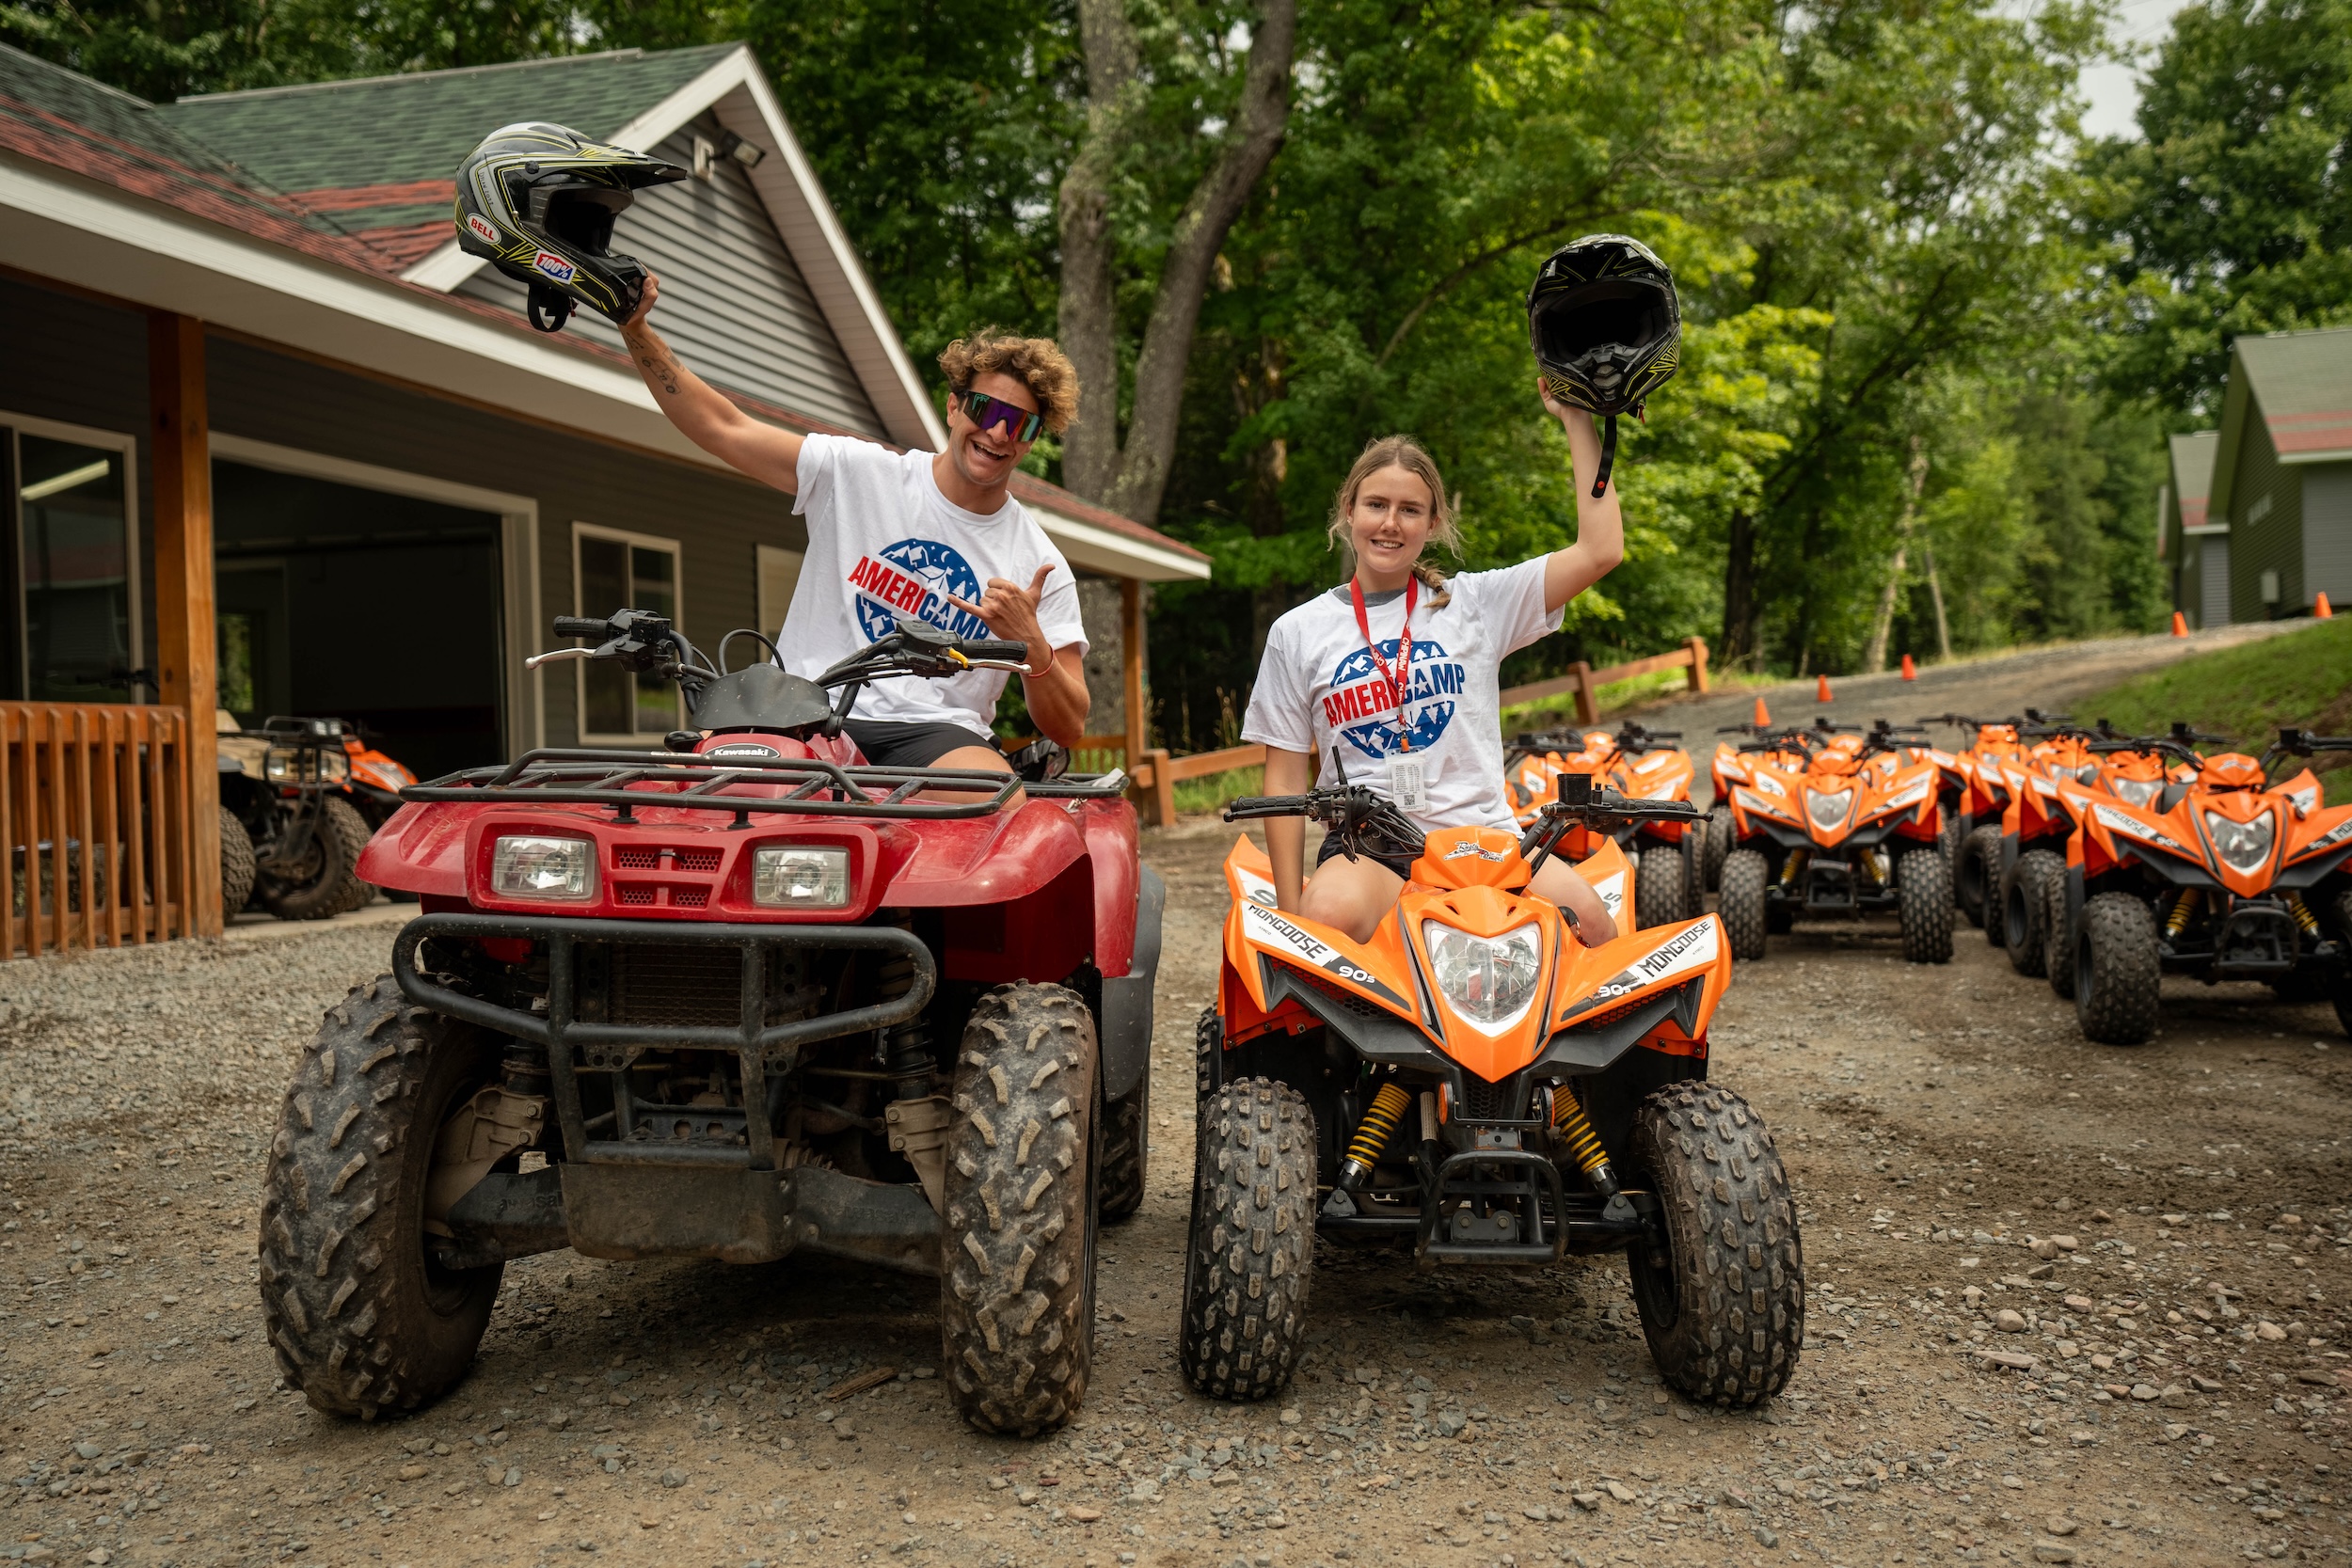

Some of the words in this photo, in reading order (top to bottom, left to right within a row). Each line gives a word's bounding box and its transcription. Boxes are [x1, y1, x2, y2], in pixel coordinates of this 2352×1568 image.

[470, 217, 495, 241] BELL
[538, 255, 572, 278] 100%
[714, 748, 769, 756] Kawasaki
[1248, 905, 1327, 958] MONGOOSE
[1338, 965, 1375, 983] 90s
[1597, 984, 1631, 997] 90s
[1636, 921, 1711, 977] MONGOOSE
